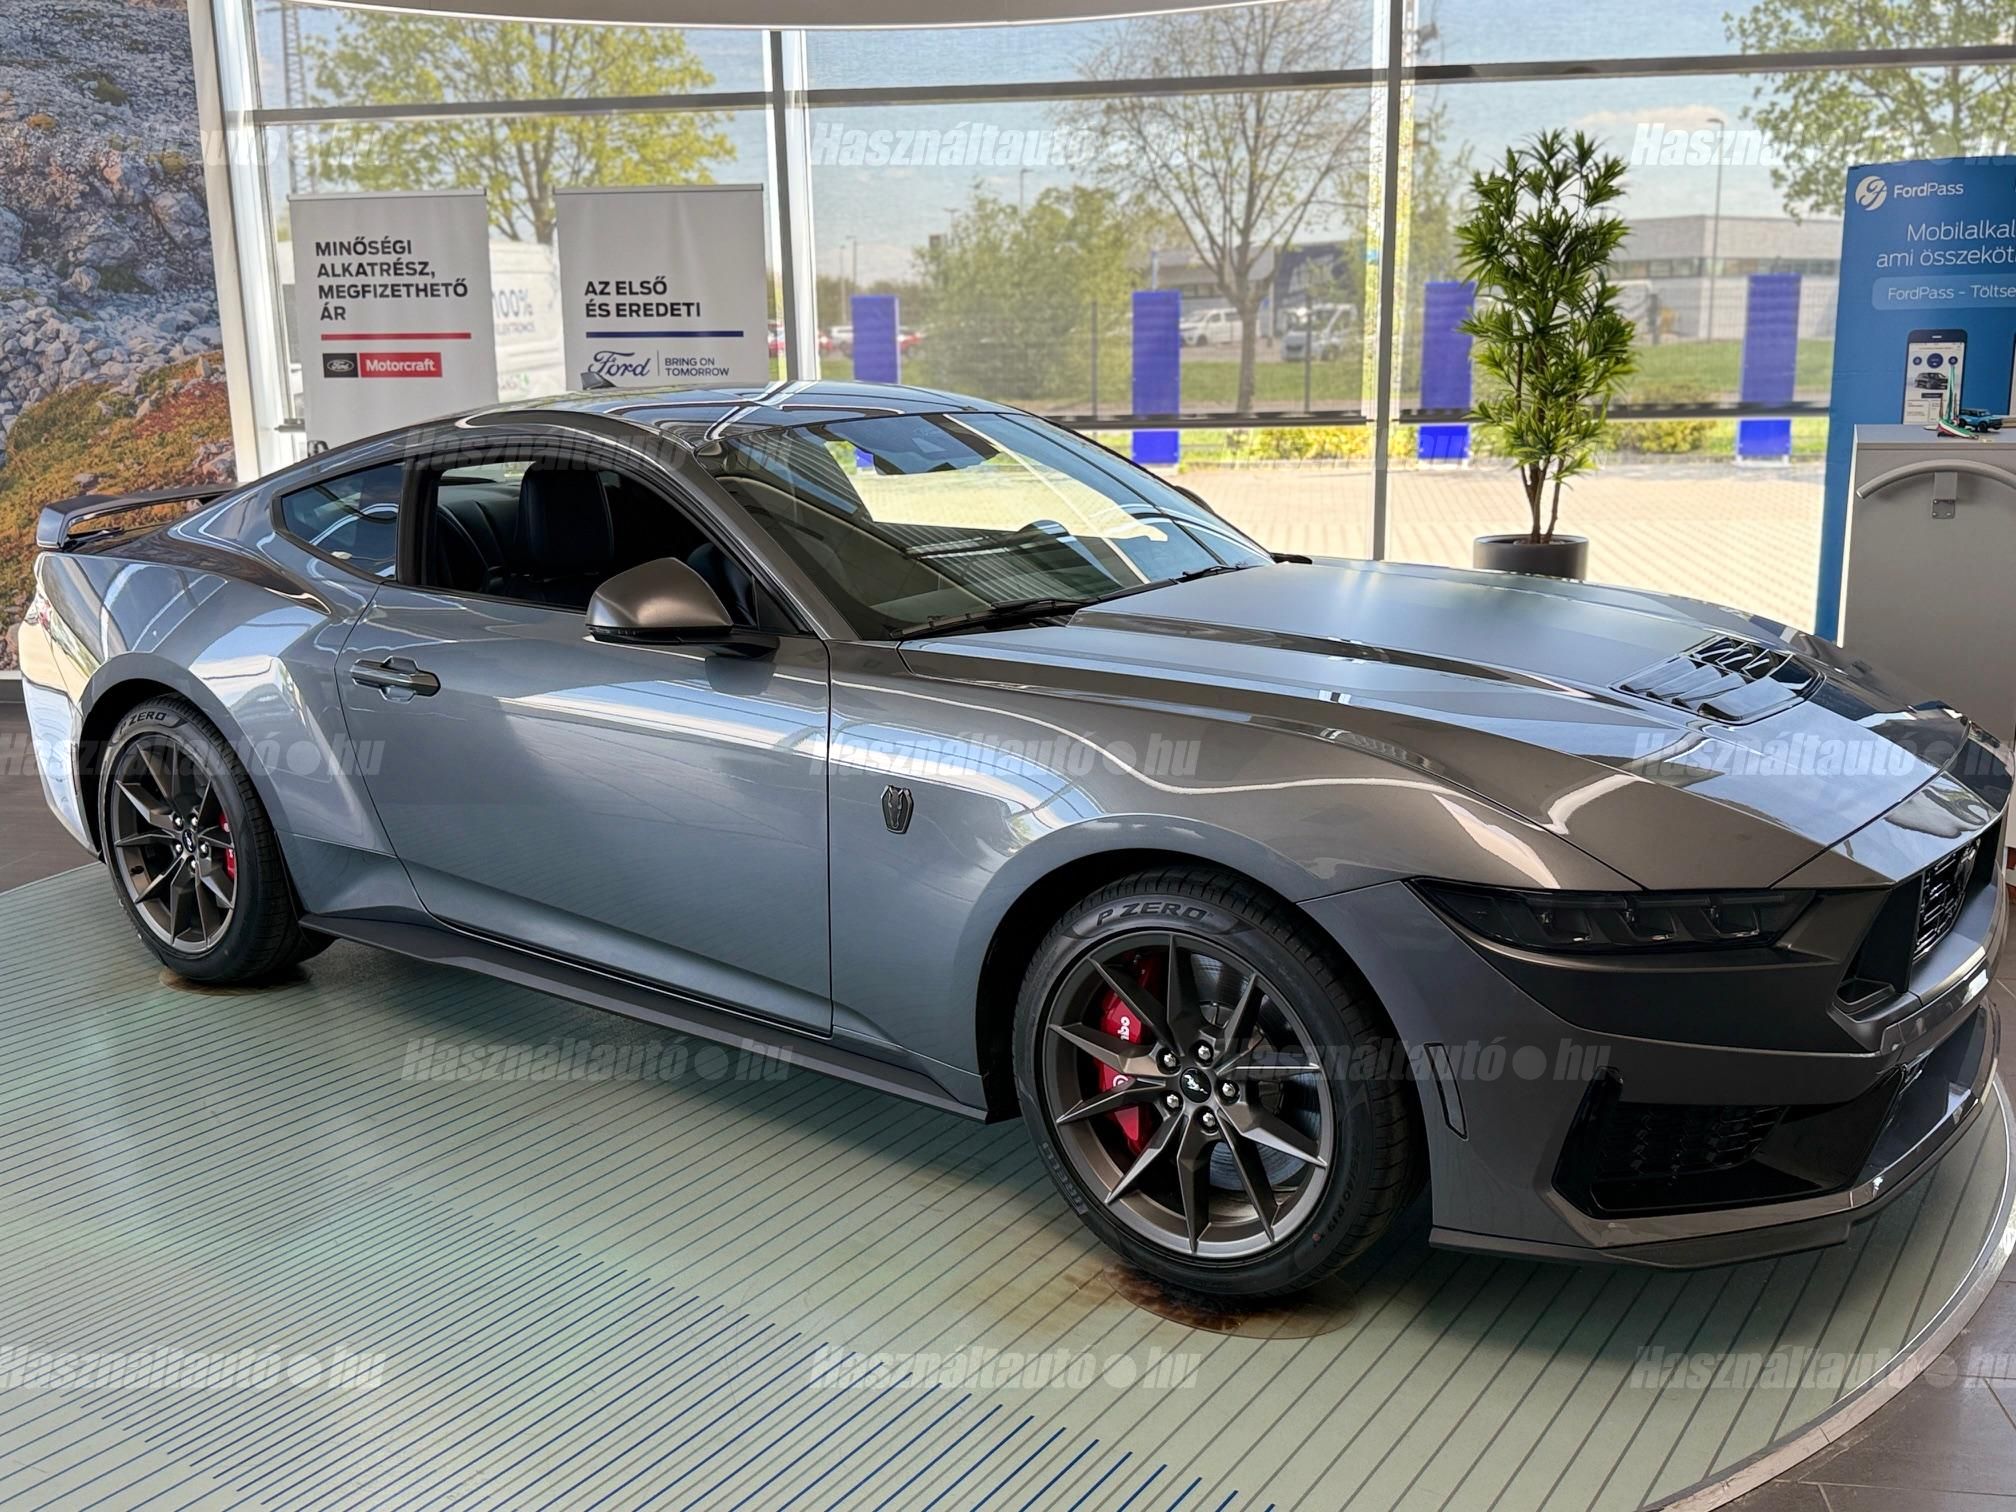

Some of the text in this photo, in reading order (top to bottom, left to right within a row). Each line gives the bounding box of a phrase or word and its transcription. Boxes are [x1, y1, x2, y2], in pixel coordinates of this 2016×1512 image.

[1893, 182, 1964, 198] FordPass
[315, 236, 412, 256] MINŐSÉGI
[1876, 245, 2016, 268] ami összeköt
[317, 257, 435, 278] ALKATRÉSZ,
[318, 278, 468, 299] MEGFIZETHETŐ
[584, 275, 668, 296] AZ ELSŐ
[1888, 286, 1954, 300] FordPass
[1969, 284, 2016, 298] Töltse
[320, 302, 346, 321] ÁR
[585, 299, 701, 318] ÉS EREDETI
[365, 358, 436, 372] Motorcraft
[588, 350, 651, 377] Ford
[664, 357, 715, 367] BRING ON
[665, 367, 730, 377] TOMORROW
[128, 711, 167, 726] ZERO
[1096, 901, 1208, 927] P ZERO
